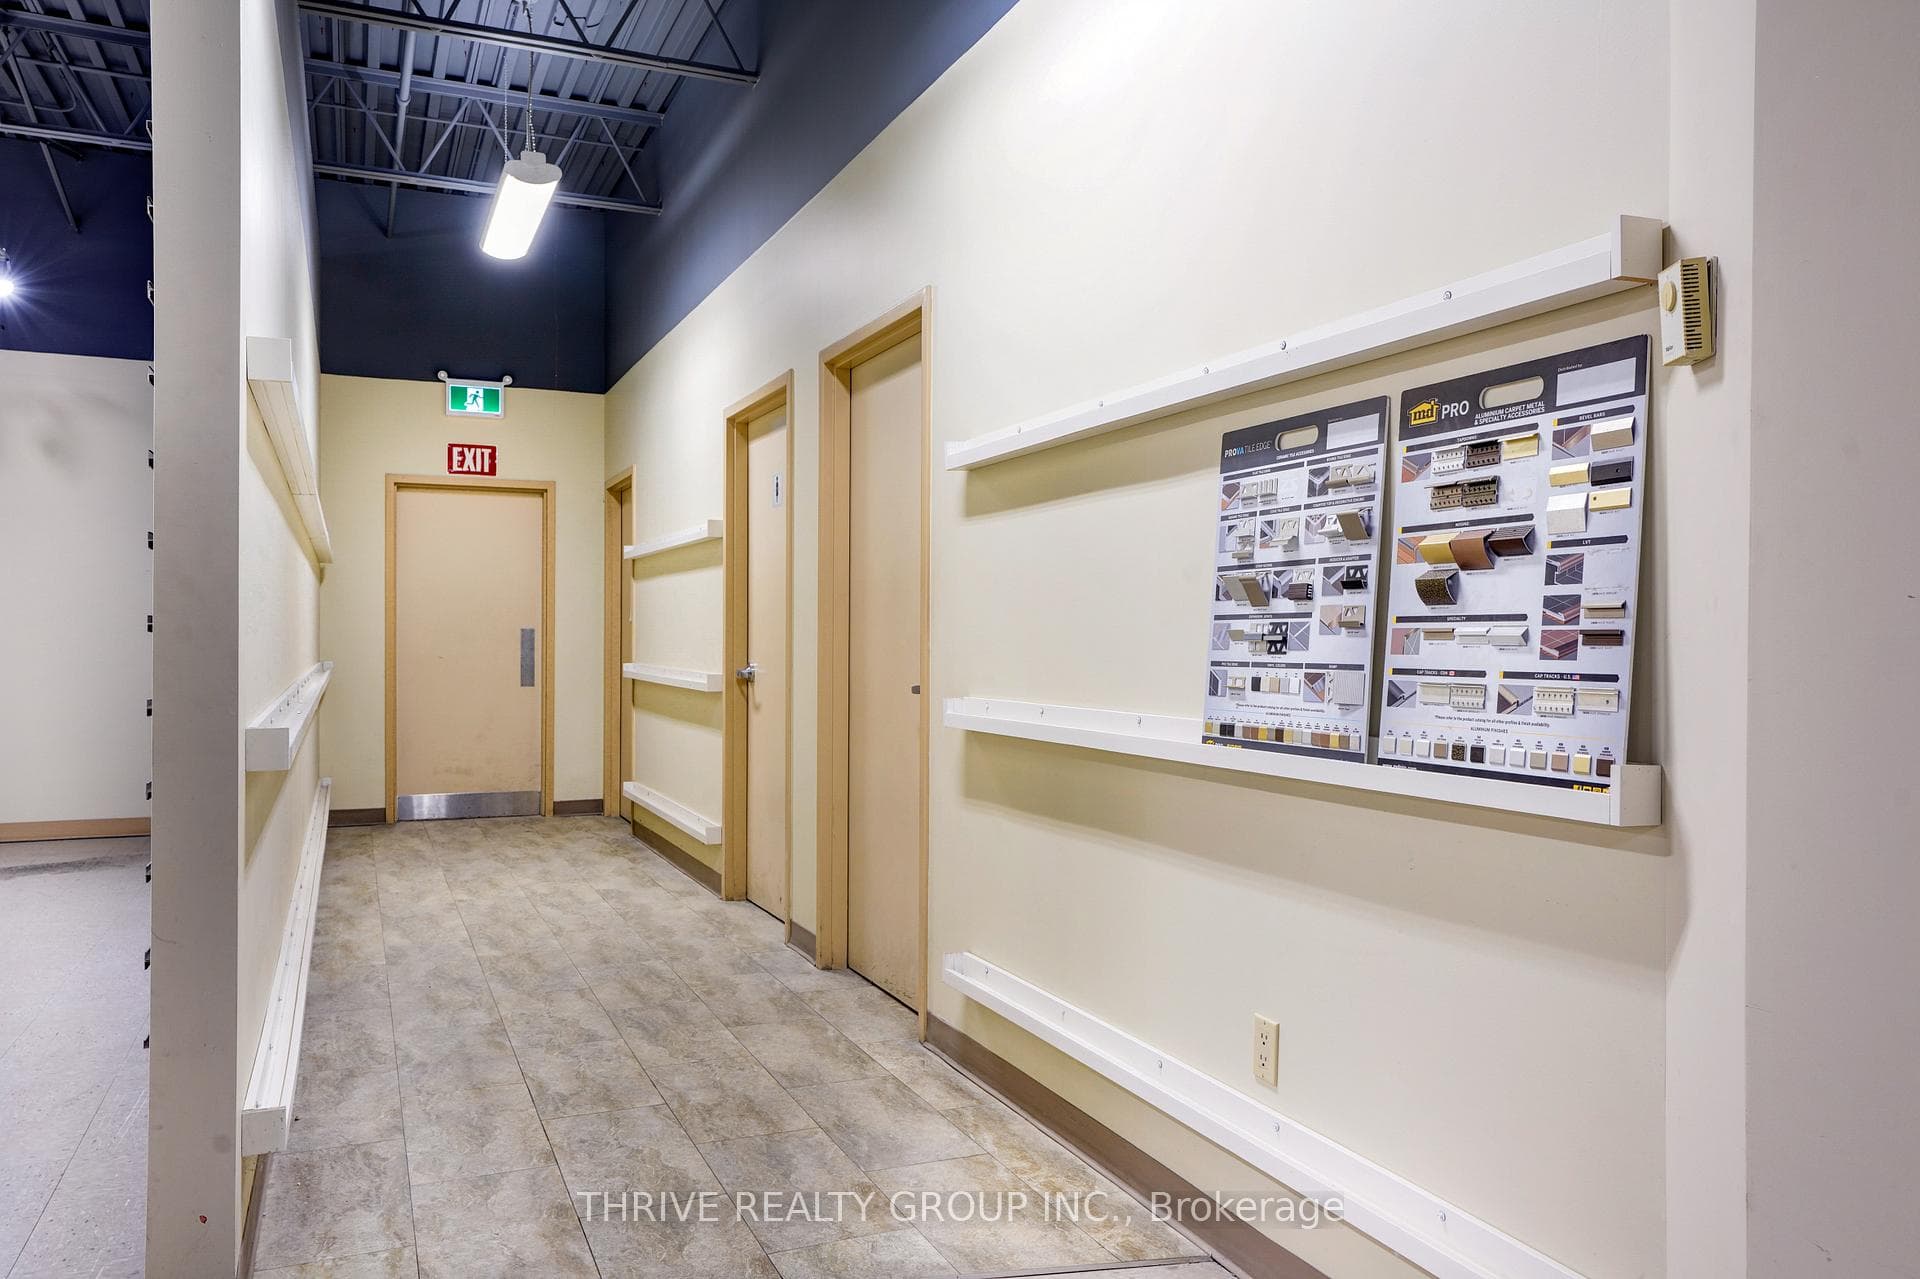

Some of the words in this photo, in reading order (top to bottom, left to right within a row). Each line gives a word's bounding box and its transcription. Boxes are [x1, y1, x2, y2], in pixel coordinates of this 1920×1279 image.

[1441, 400, 1469, 419] PRO
[1479, 414, 1507, 424] SPECIALTY
[1507, 407, 1545, 419] ACCESSORIES
[1504, 404, 1525, 414] CARPET
[1526, 401, 1545, 410] METAL
[1224, 447, 1244, 458] PROVA
[1256, 440, 1271, 451] EDGE
[452, 446, 492, 473] EXIT
